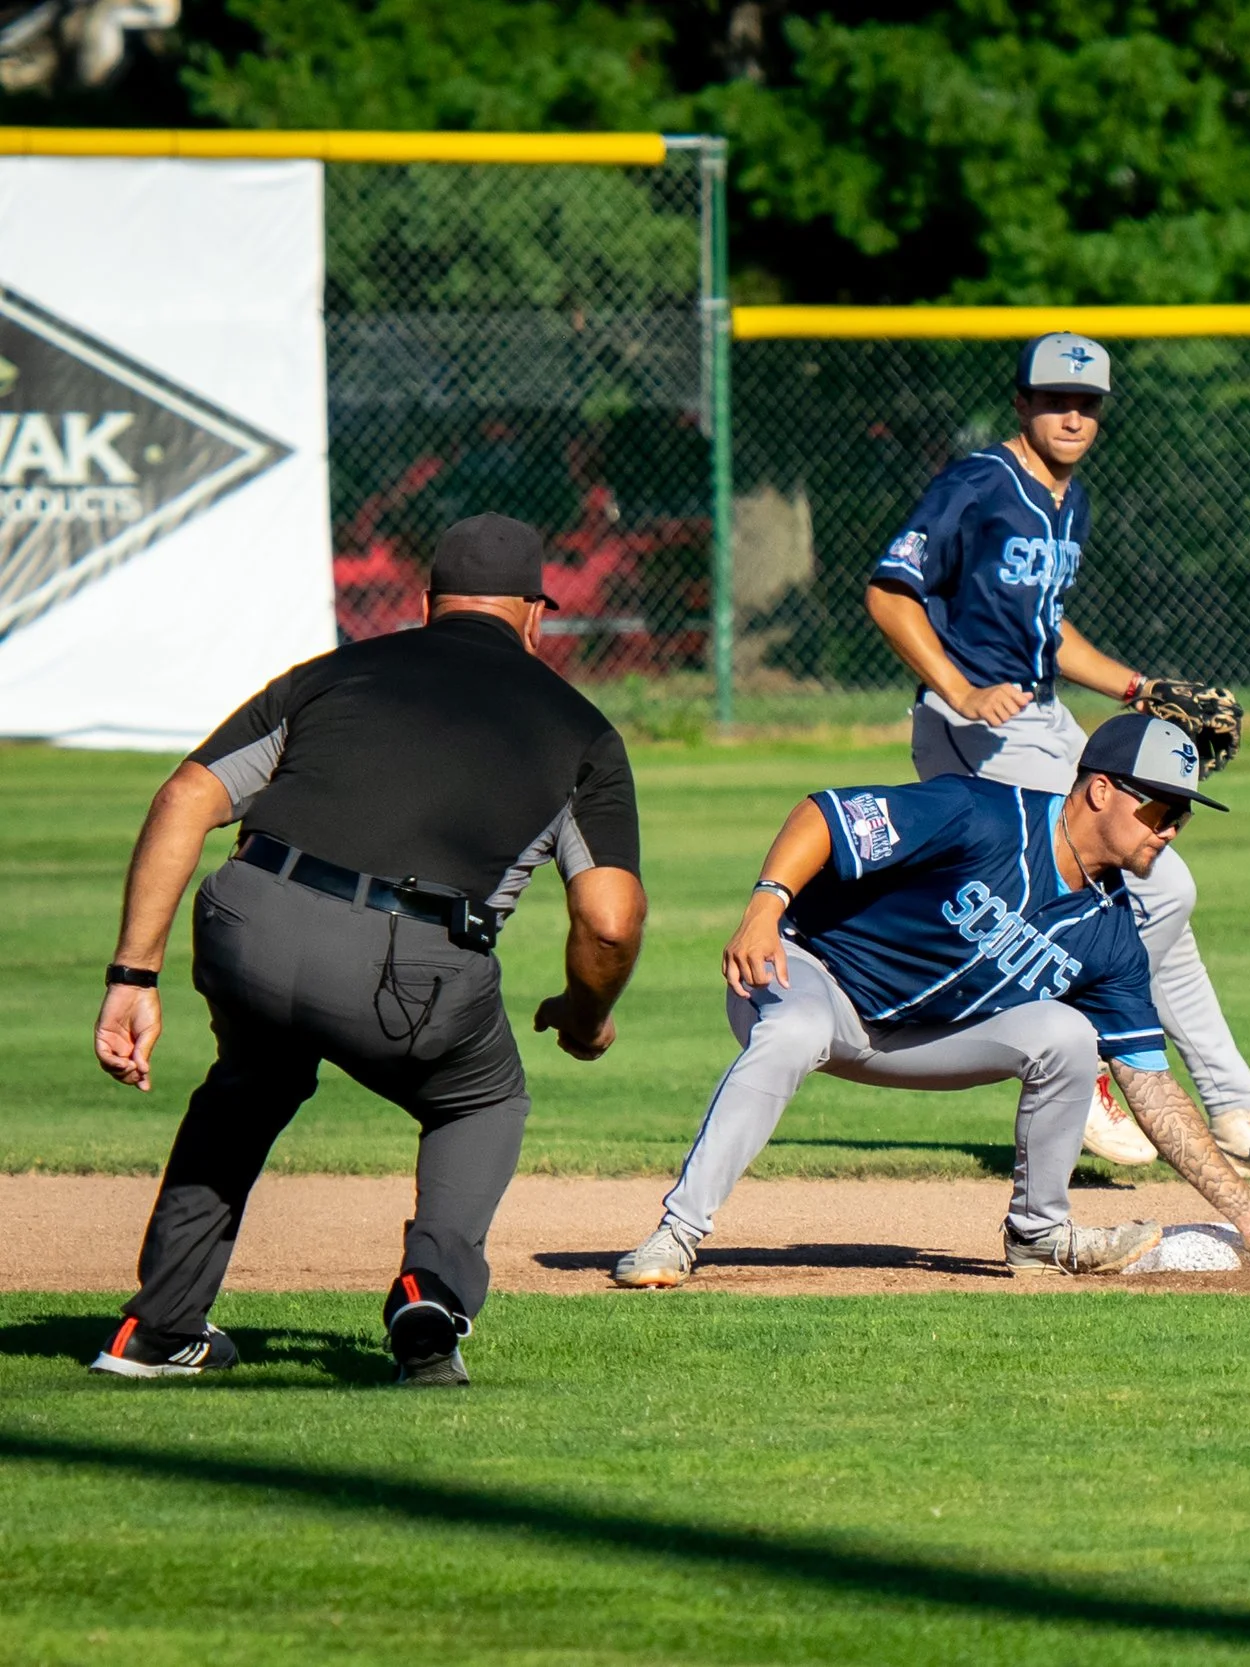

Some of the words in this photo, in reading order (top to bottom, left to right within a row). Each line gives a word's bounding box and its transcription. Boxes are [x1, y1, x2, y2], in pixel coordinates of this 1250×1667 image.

[0, 487, 142, 520] ODUCTS
[869, 827, 893, 861] LAKES
[942, 881, 1082, 1001] SCOUTS
